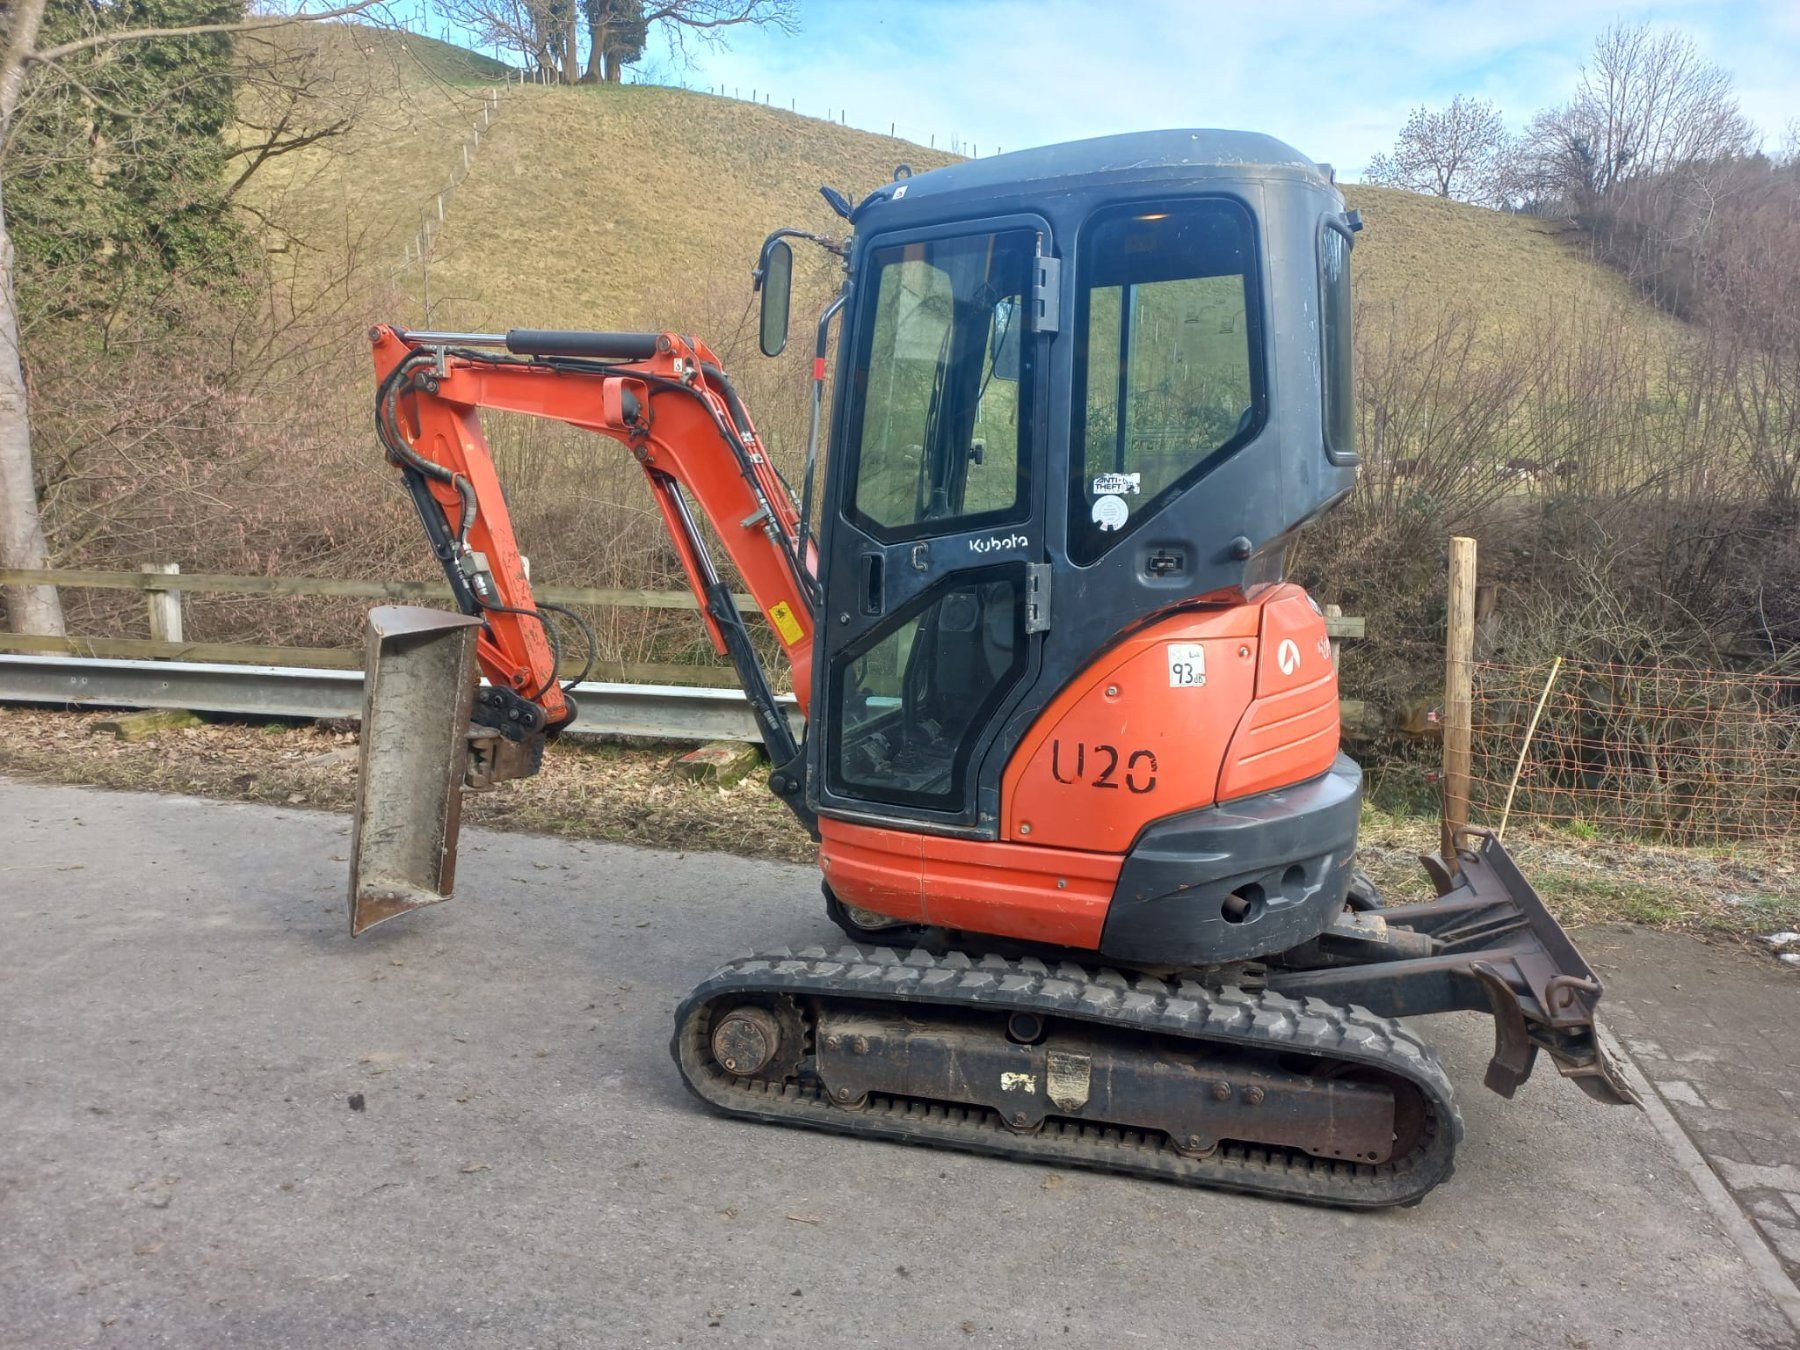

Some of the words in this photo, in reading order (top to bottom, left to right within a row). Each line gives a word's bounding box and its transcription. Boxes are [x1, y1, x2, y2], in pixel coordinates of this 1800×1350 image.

[969, 533, 1029, 553] Kubota
[1172, 663, 1193, 684] 93
[1052, 739, 1158, 794] U20
